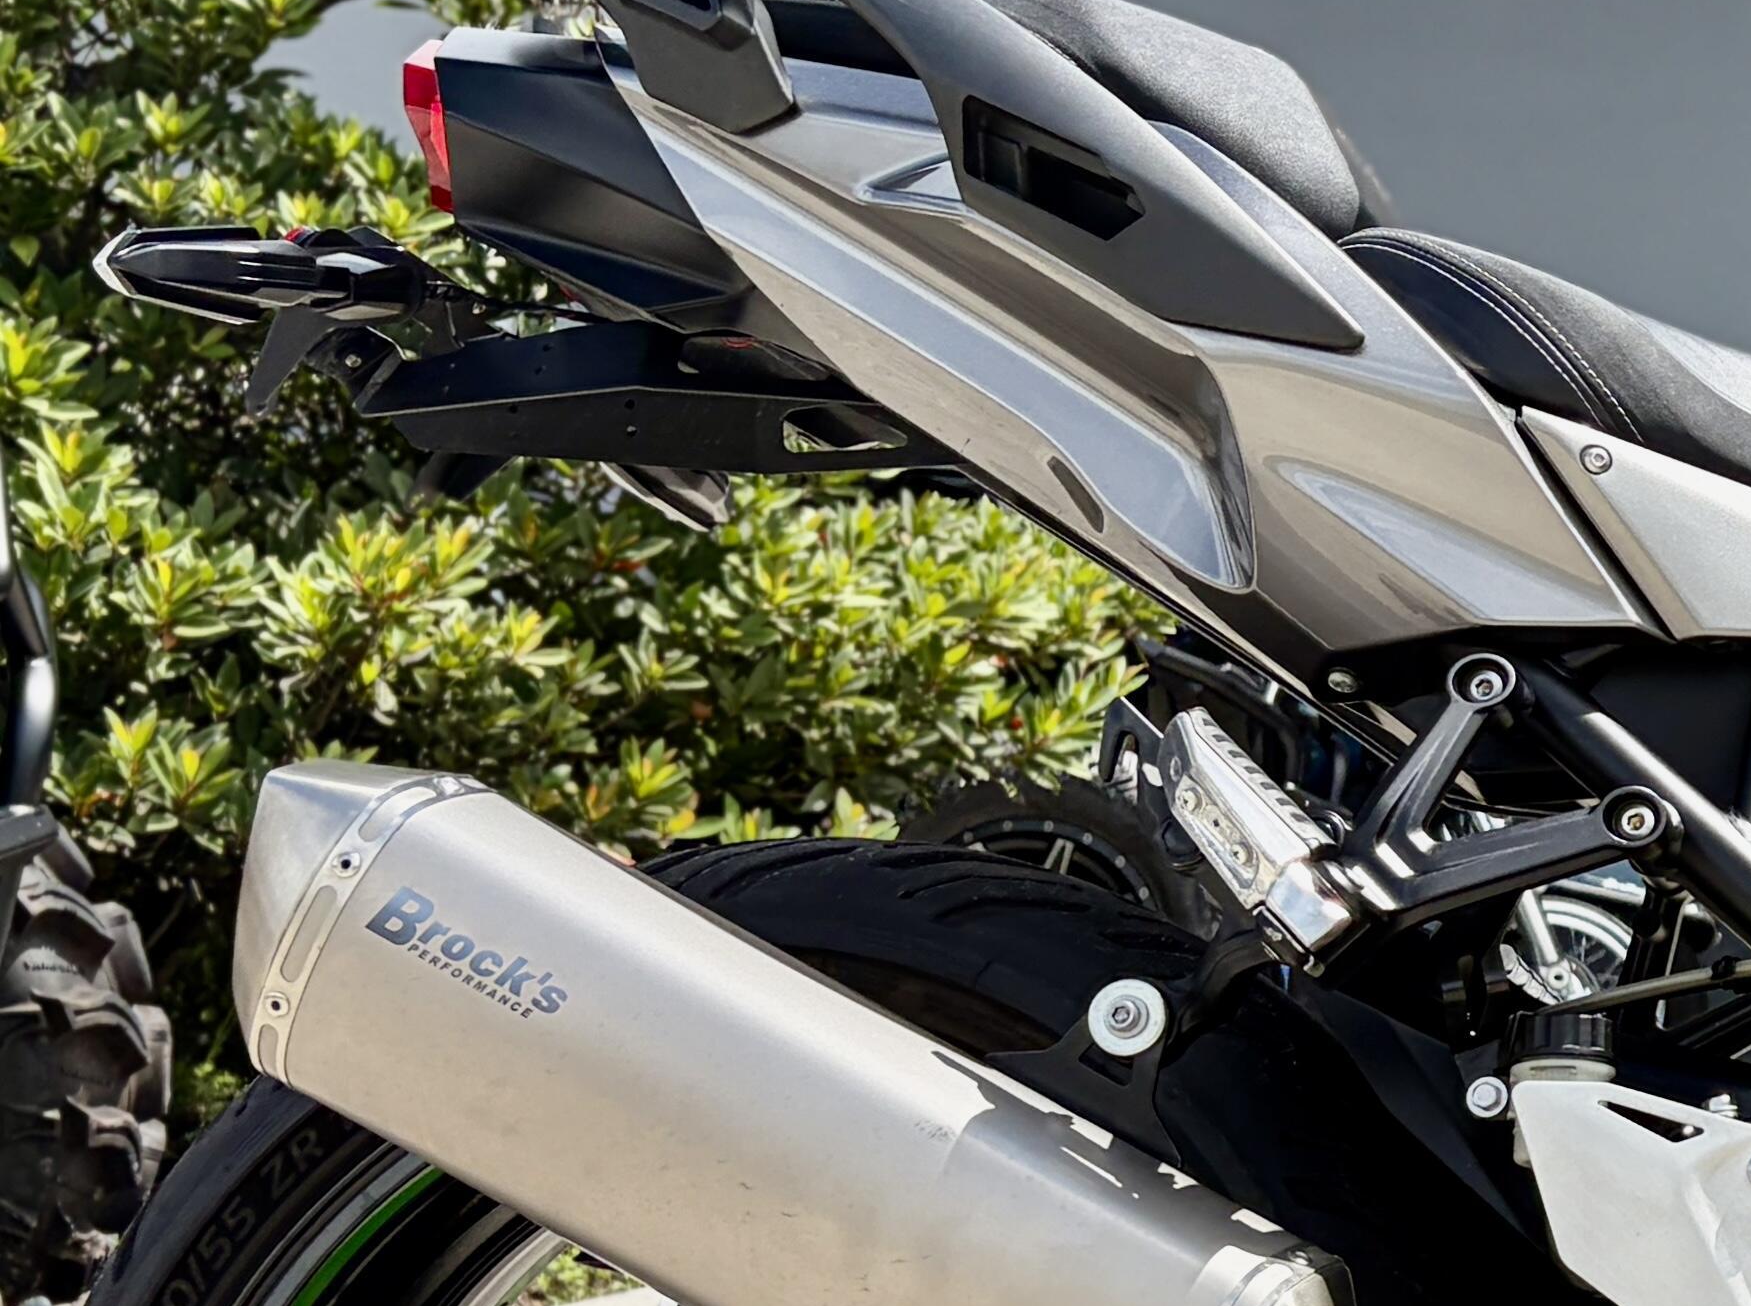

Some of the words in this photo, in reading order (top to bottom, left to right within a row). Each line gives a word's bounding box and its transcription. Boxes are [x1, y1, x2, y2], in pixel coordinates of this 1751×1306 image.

[365, 885, 569, 1015] Brock's
[406, 943, 534, 1020] PERFORMANCE
[260, 1127, 325, 1183] ZR
